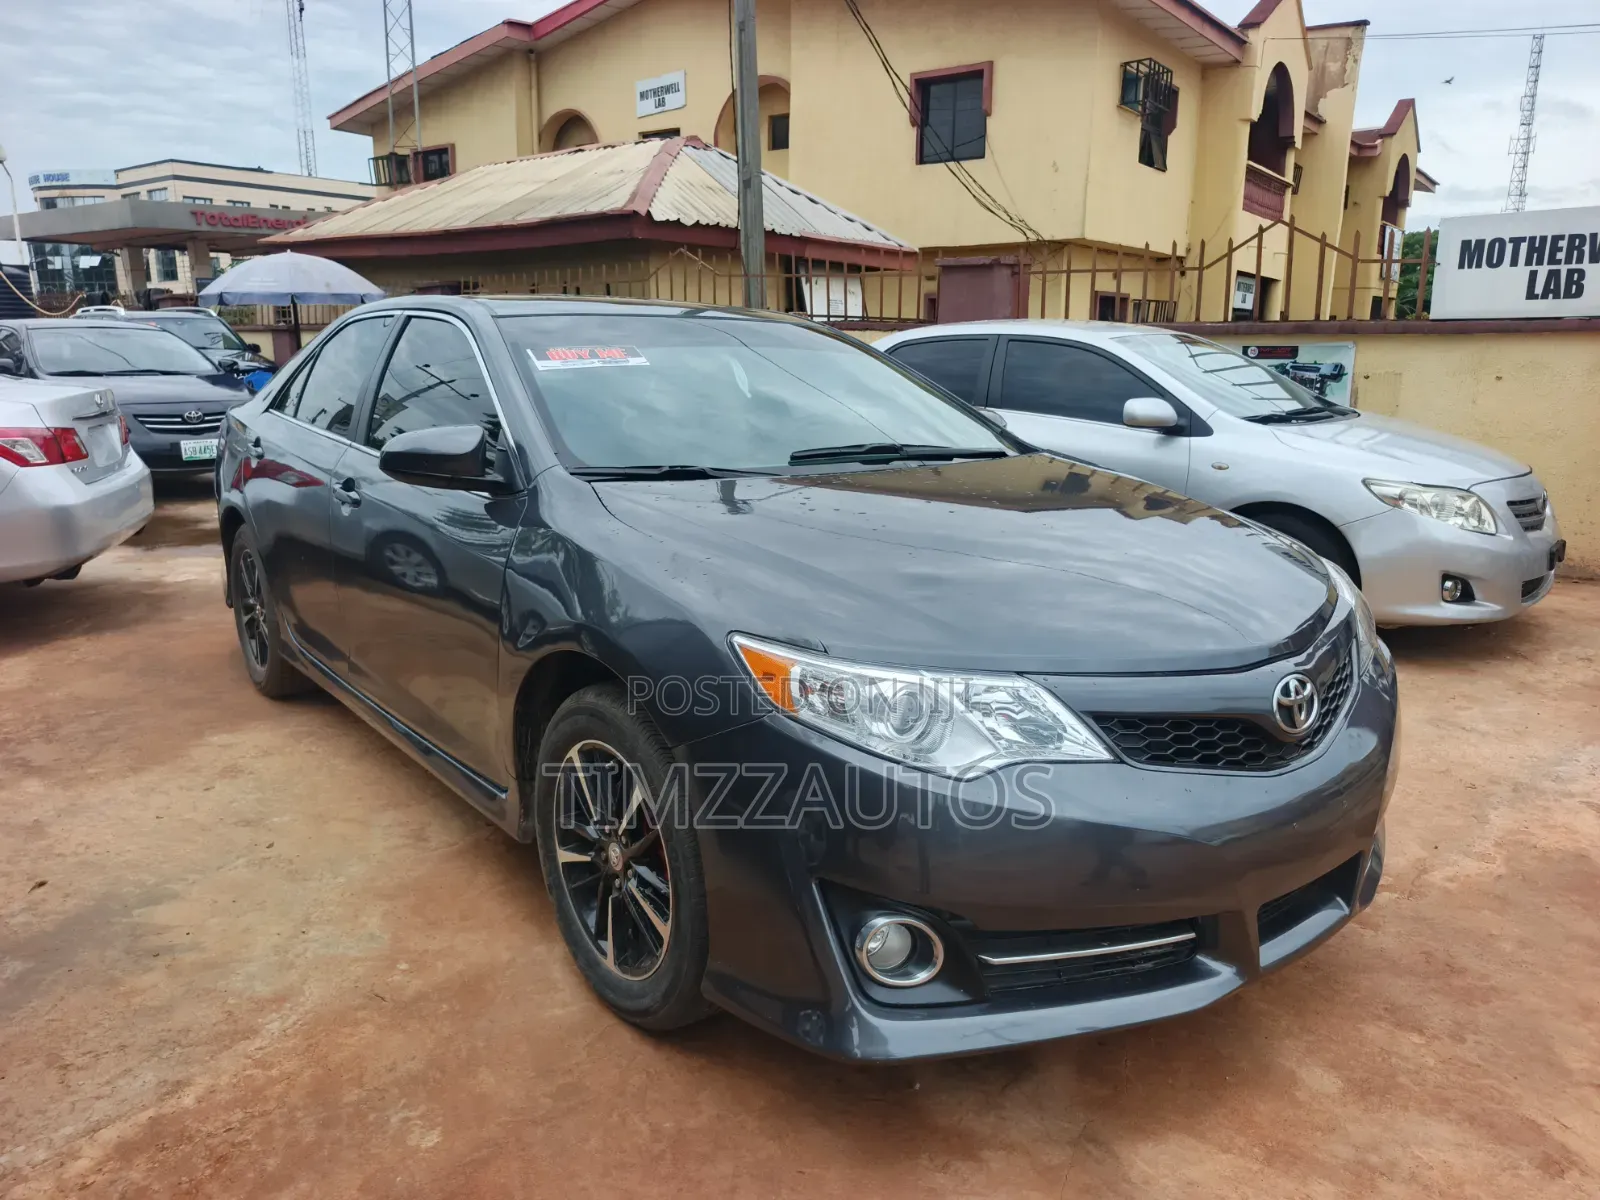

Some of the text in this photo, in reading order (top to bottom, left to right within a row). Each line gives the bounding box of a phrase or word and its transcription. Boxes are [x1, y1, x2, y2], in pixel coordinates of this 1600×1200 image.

[639, 81, 680, 101] MOTHERWELL
[654, 96, 666, 109] LAB
[1525, 268, 1586, 300] LAB
